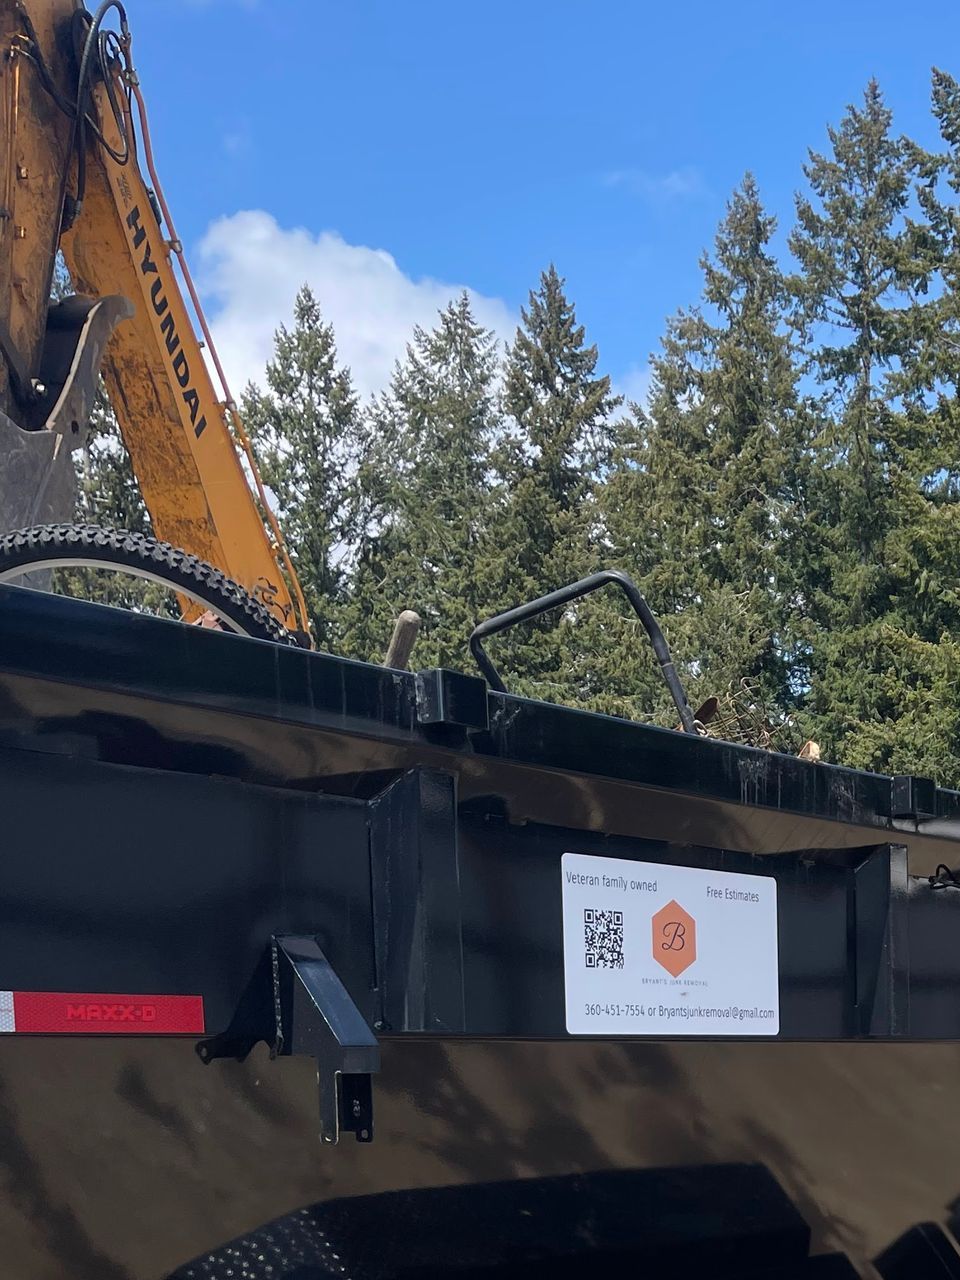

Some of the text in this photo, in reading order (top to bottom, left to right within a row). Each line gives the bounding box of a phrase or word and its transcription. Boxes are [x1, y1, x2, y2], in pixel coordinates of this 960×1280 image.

[127, 206, 207, 439] HYUNDAI
[566, 871, 658, 892] Veteran family owned
[706, 886, 759, 902] Free Estimates
[584, 1003, 775, 1020] 360-451-7554 or Bryantsjunkremoval@gmail.com
